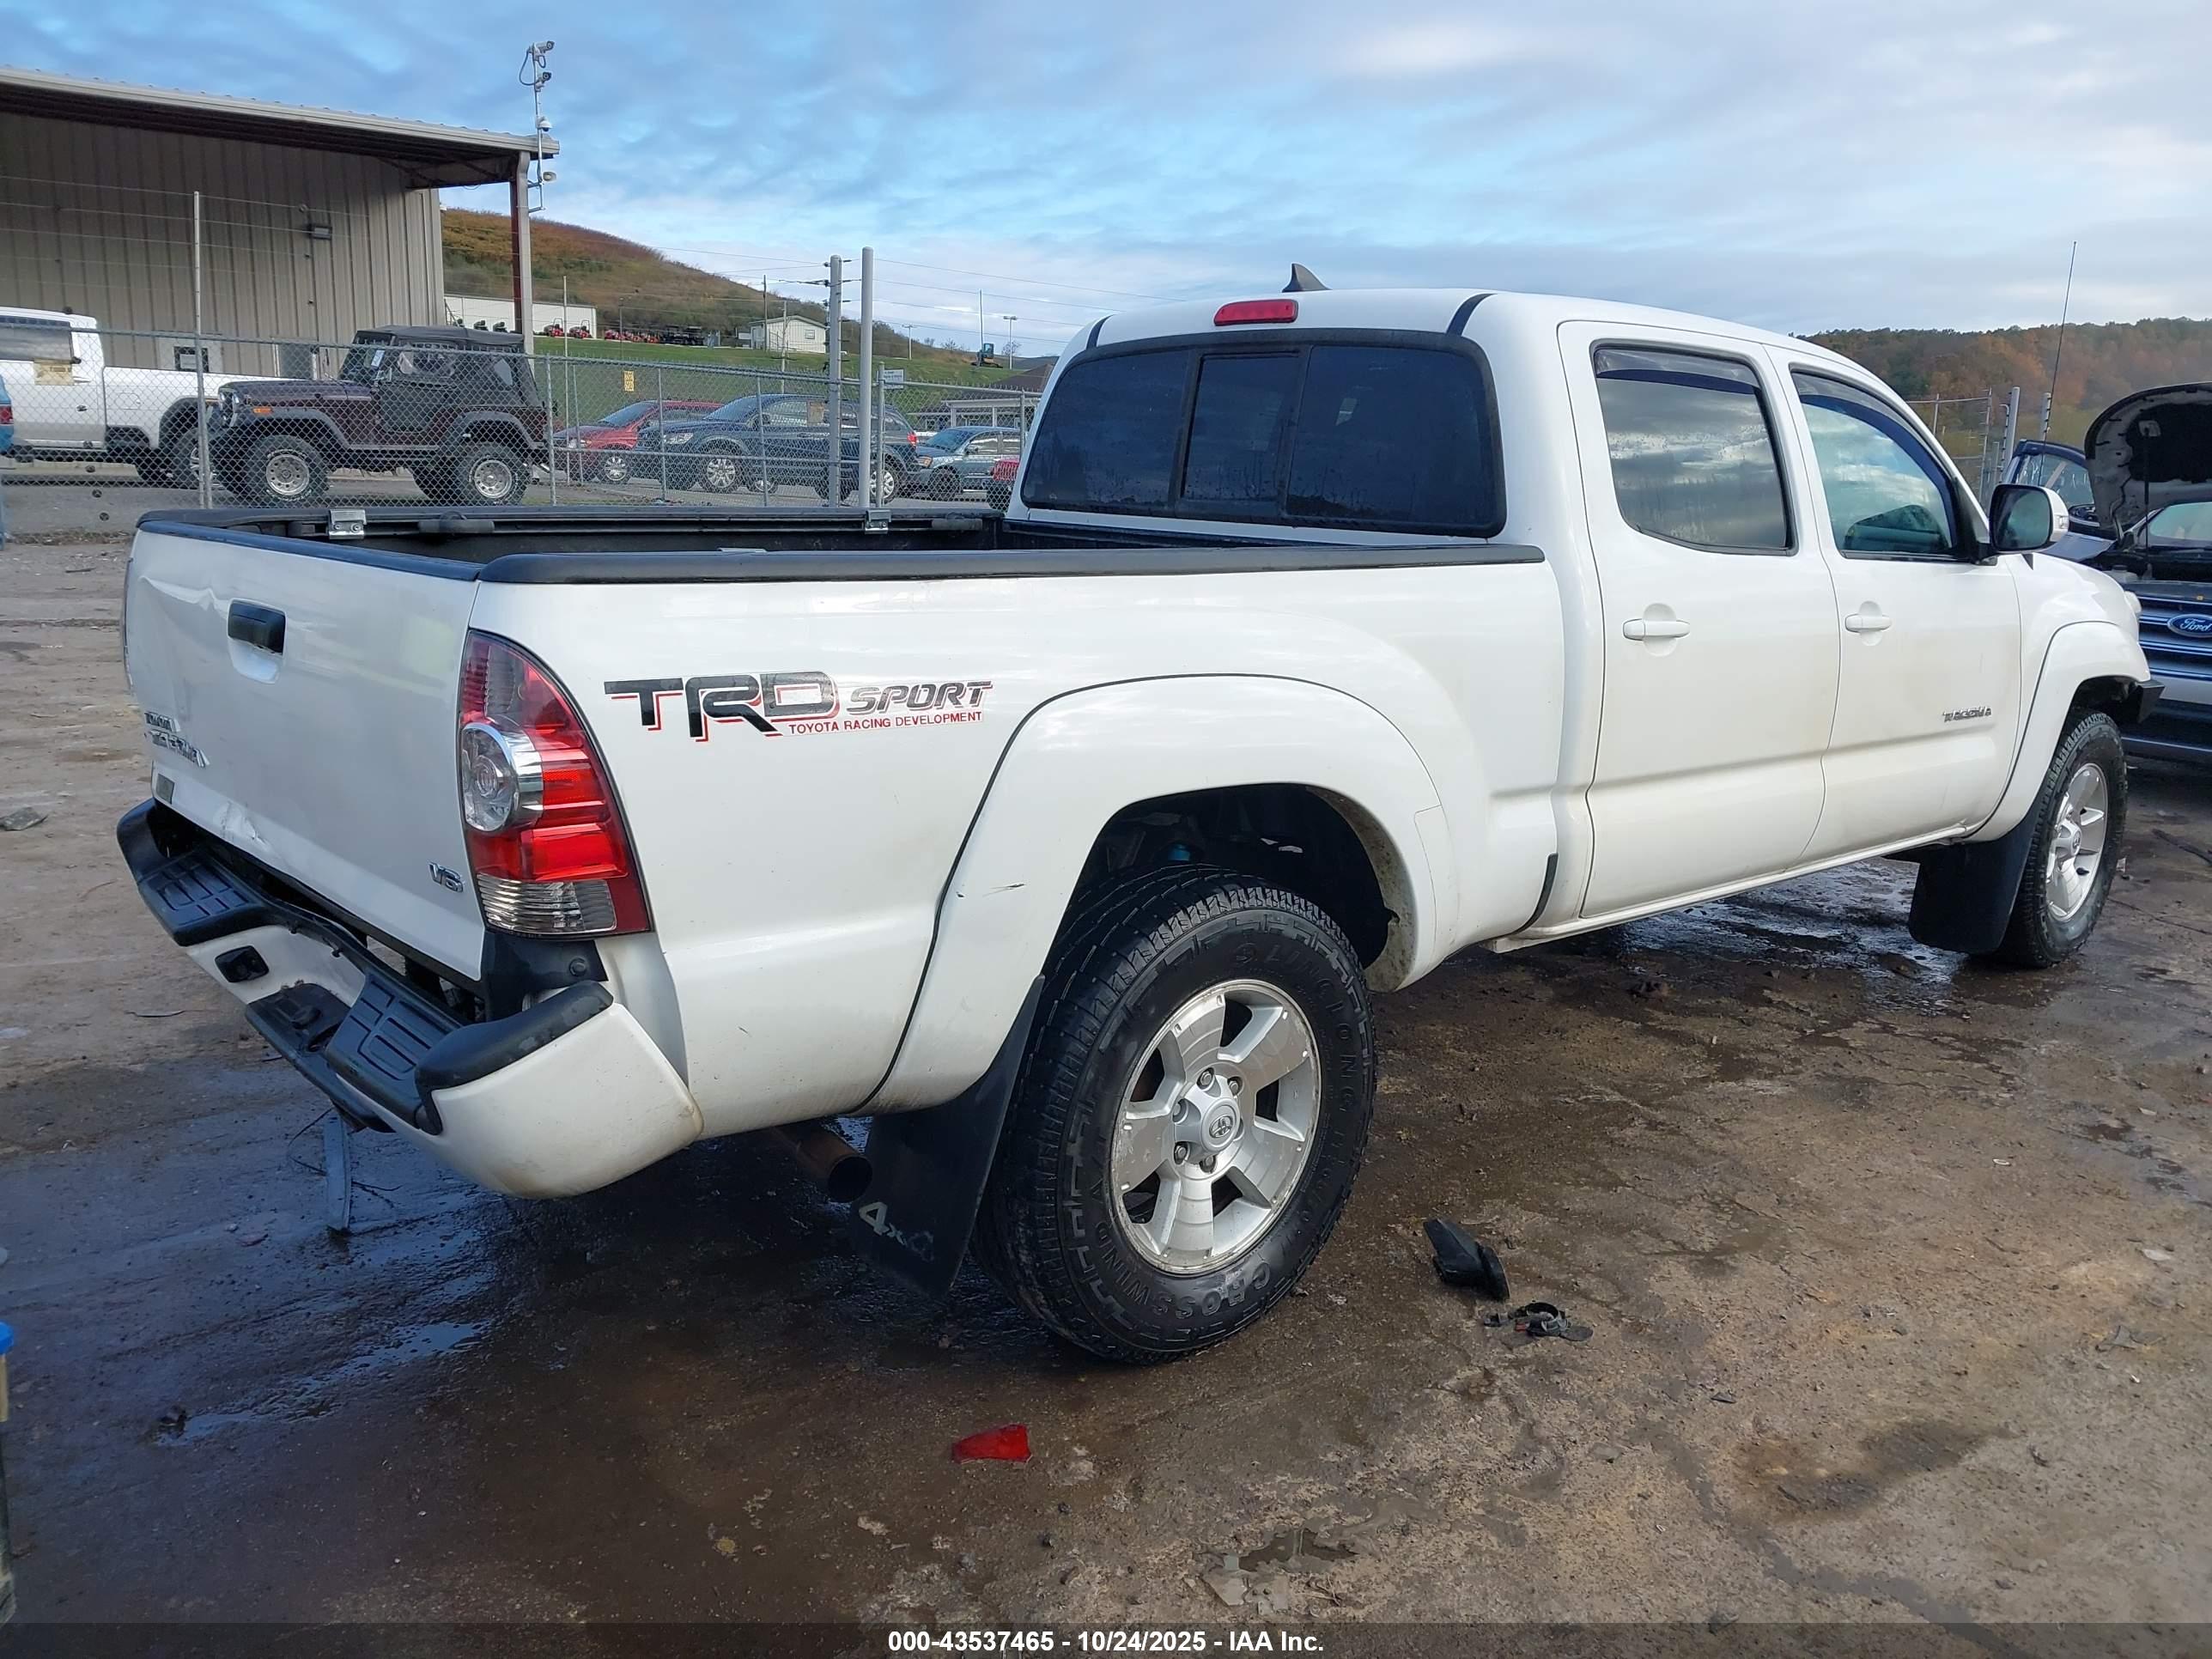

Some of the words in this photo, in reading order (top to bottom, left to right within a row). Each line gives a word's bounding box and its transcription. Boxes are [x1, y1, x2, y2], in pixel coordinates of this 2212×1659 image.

[2179, 617, 2212, 633] Ford
[604, 671, 841, 743] TRD
[846, 680, 994, 716] SPORT
[1942, 706, 1993, 723] TACOMA
[788, 720, 840, 735] TOYOTA
[844, 717, 891, 731] RACING
[896, 710, 982, 727] DEVELOPMENT
[428, 860, 465, 893] V6
